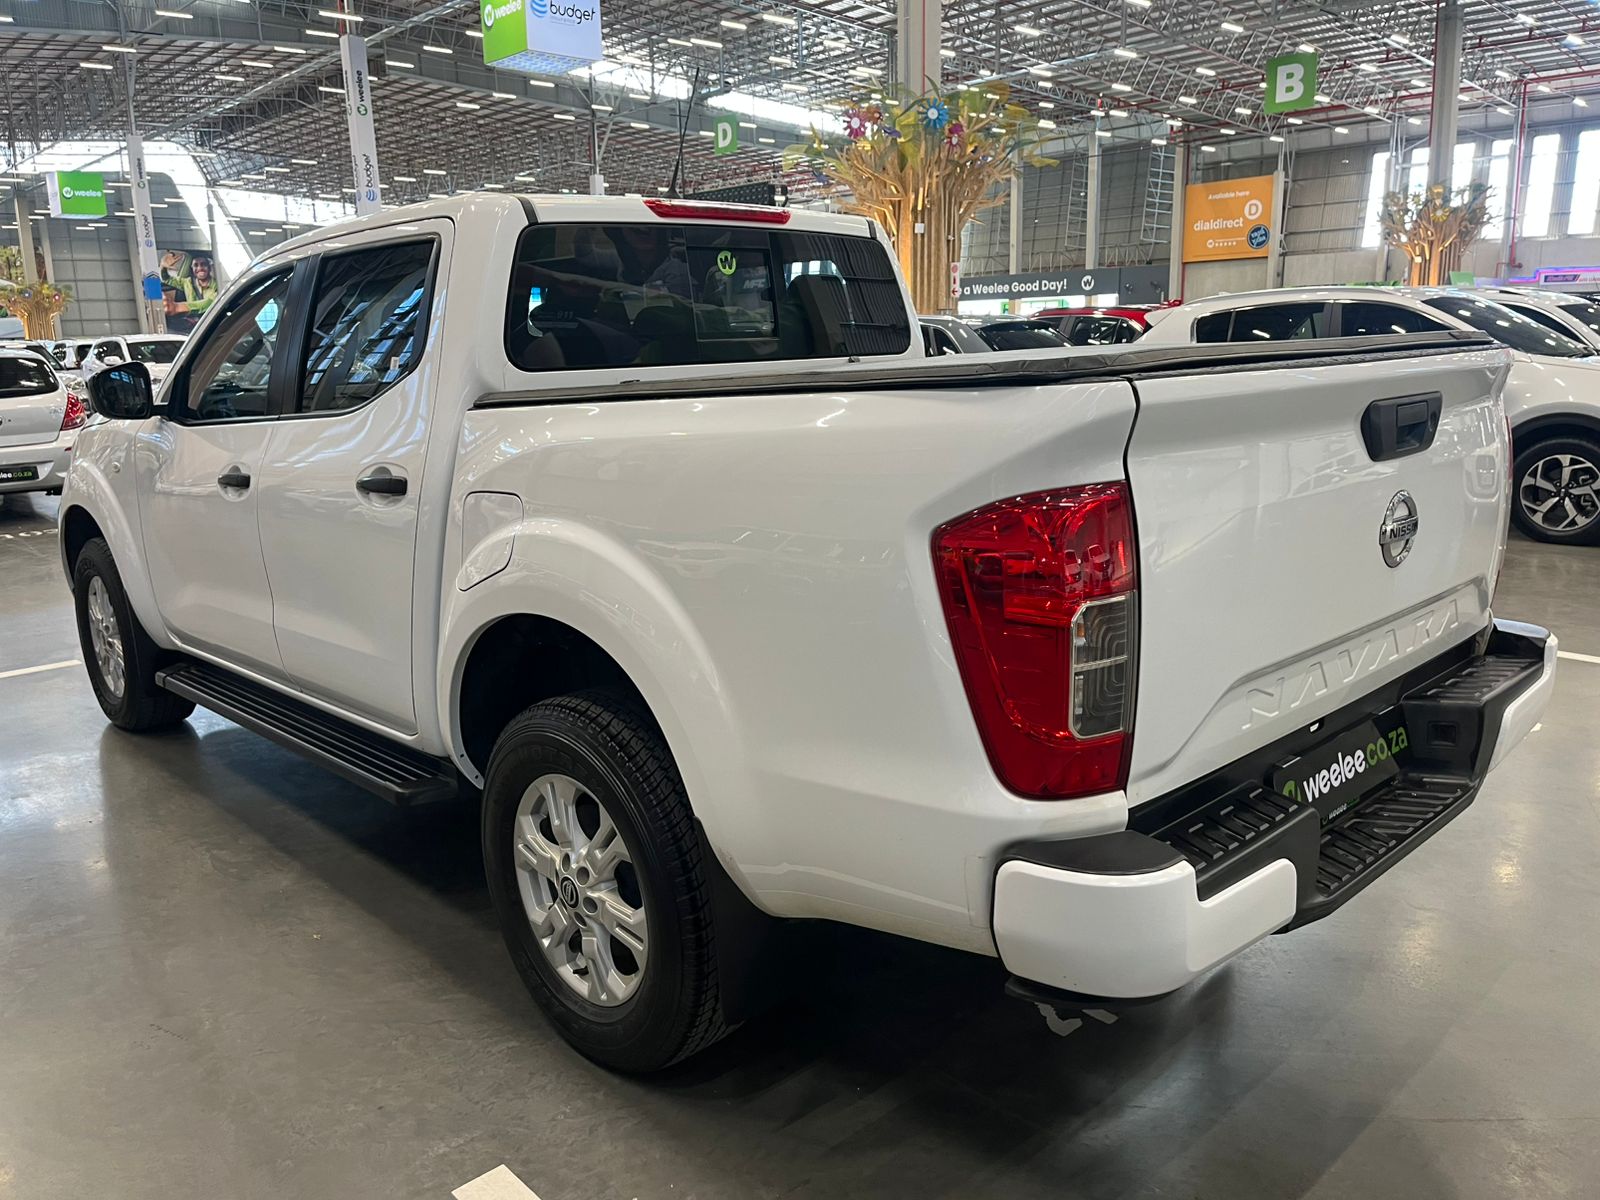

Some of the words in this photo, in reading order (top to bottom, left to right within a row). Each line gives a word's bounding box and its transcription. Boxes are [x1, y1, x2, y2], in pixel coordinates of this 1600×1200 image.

[550, 0, 595, 24] budget
[1275, 63, 1304, 104] B
[717, 122, 732, 148] D
[1193, 216, 1243, 231] dialdirect
[963, 286, 971, 295] a
[972, 282, 1010, 295] Weelee
[1011, 280, 1040, 293] Good
[1041, 278, 1067, 294] Day!
[1241, 598, 1459, 730] NAVARA
[1303, 726, 1408, 803] weelee.co.za
